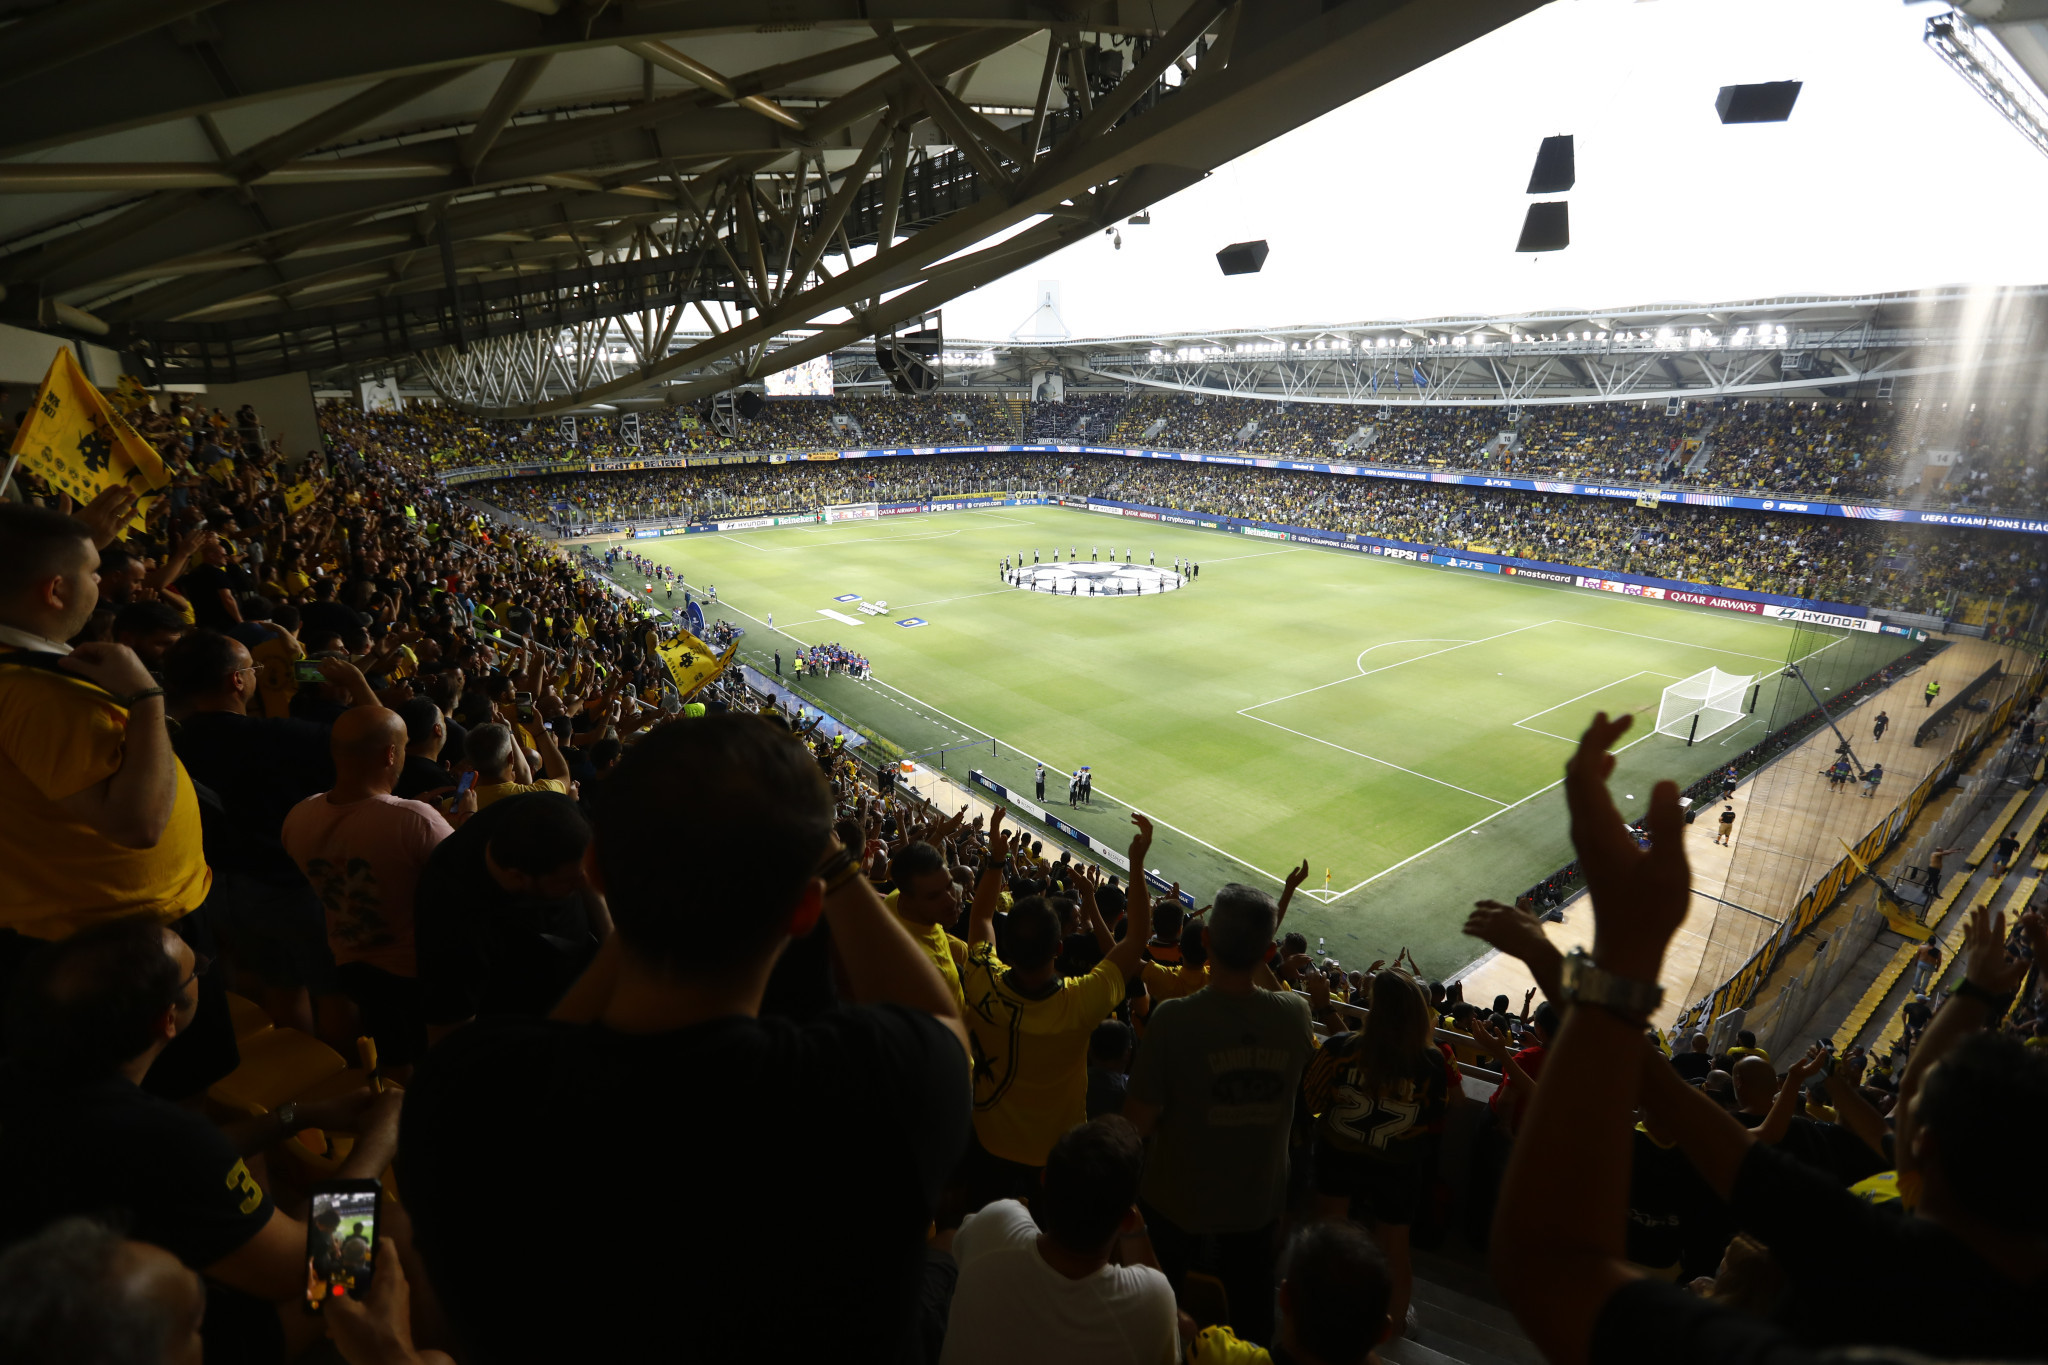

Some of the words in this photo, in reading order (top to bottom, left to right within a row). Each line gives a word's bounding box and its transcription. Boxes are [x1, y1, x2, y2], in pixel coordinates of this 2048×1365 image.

[643, 459, 683, 468] BELIEVE
[688, 458, 719, 466] NEVER
[721, 456, 742, 465] GIVE
[746, 455, 760, 463] UP
[1377, 470, 1407, 478] CHAMPIONS
[896, 506, 918, 514] AIRWAYS
[930, 503, 955, 512] PEPSI
[973, 500, 1002, 508] crypto.com
[738, 520, 768, 528] HYUNDAI
[778, 515, 815, 525] Heineken
[1166, 516, 1196, 526] crypto.com
[1920, 514, 1948, 523] UEFA
[1950, 516, 2020, 530] CHAMPIONS
[663, 528, 686, 536] bet365
[1244, 526, 1279, 539] Heineken
[1311, 537, 1340, 548] CHAMPIONS
[1340, 541, 1360, 551] LEAGUE
[1383, 547, 1418, 561] PEPSI
[1458, 560, 1484, 570] PS5
[1517, 569, 1571, 584] mastercard
[1582, 578, 1615, 592] FedEx
[1622, 583, 1657, 598] FedEx
[1670, 592, 1706, 605] QATAR
[1709, 598, 1757, 613] AIRWAYS
[1802, 612, 1867, 630] HYUNDAI
[1107, 851, 1125, 865] RESPECT
[1328, 1084, 1421, 1152] 27
[225, 1156, 264, 1215] 3
